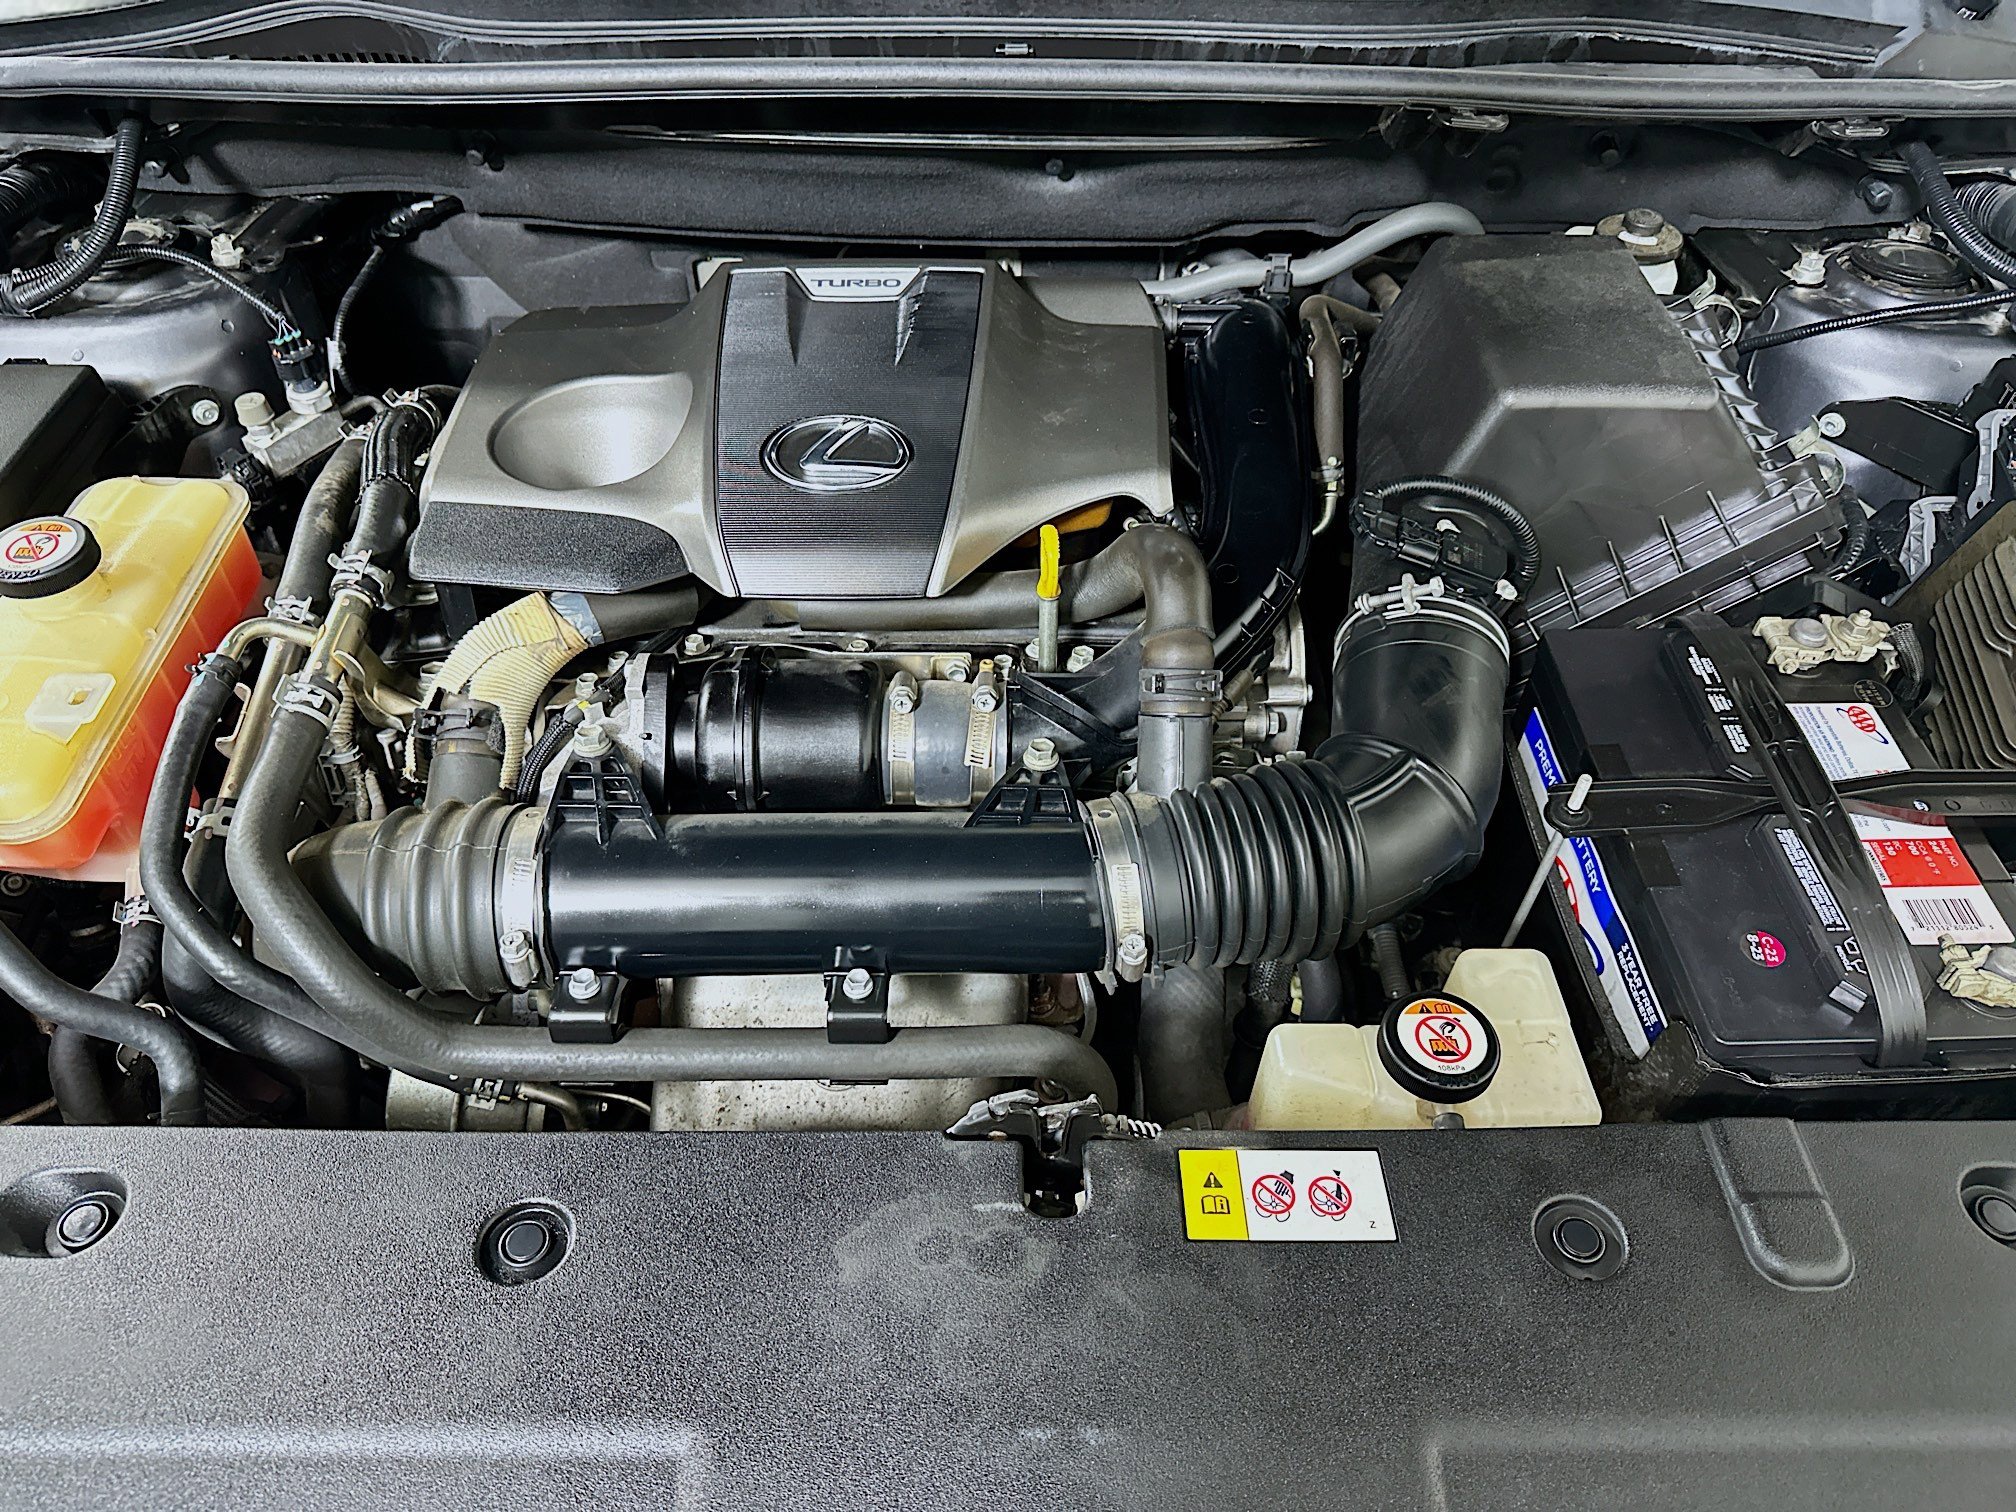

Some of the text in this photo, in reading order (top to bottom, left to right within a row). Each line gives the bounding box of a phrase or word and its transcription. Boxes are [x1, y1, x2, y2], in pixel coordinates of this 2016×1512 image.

[810, 278, 902, 288] TURBO
[0, 569, 41, 580] ENSO
[1848, 706, 1876, 732] AAA
[1534, 738, 1602, 893] PREM TTERY
[1871, 841, 1888, 862] SERIAL
[1882, 841, 1897, 857] 130
[1892, 841, 1903, 851] RC
[1905, 841, 1920, 856] 700
[1915, 841, 1929, 856] CCA
[1928, 840, 1943, 855] 24F
[1938, 840, 1951, 857] PART
[1746, 933, 1765, 961] 8-23
[1761, 936, 1779, 963] C-23
[1621, 942, 1659, 1025] 3 YEAR FREE
[1437, 1064, 1466, 1072] 108kPa
[1369, 1220, 1377, 1228] Z
